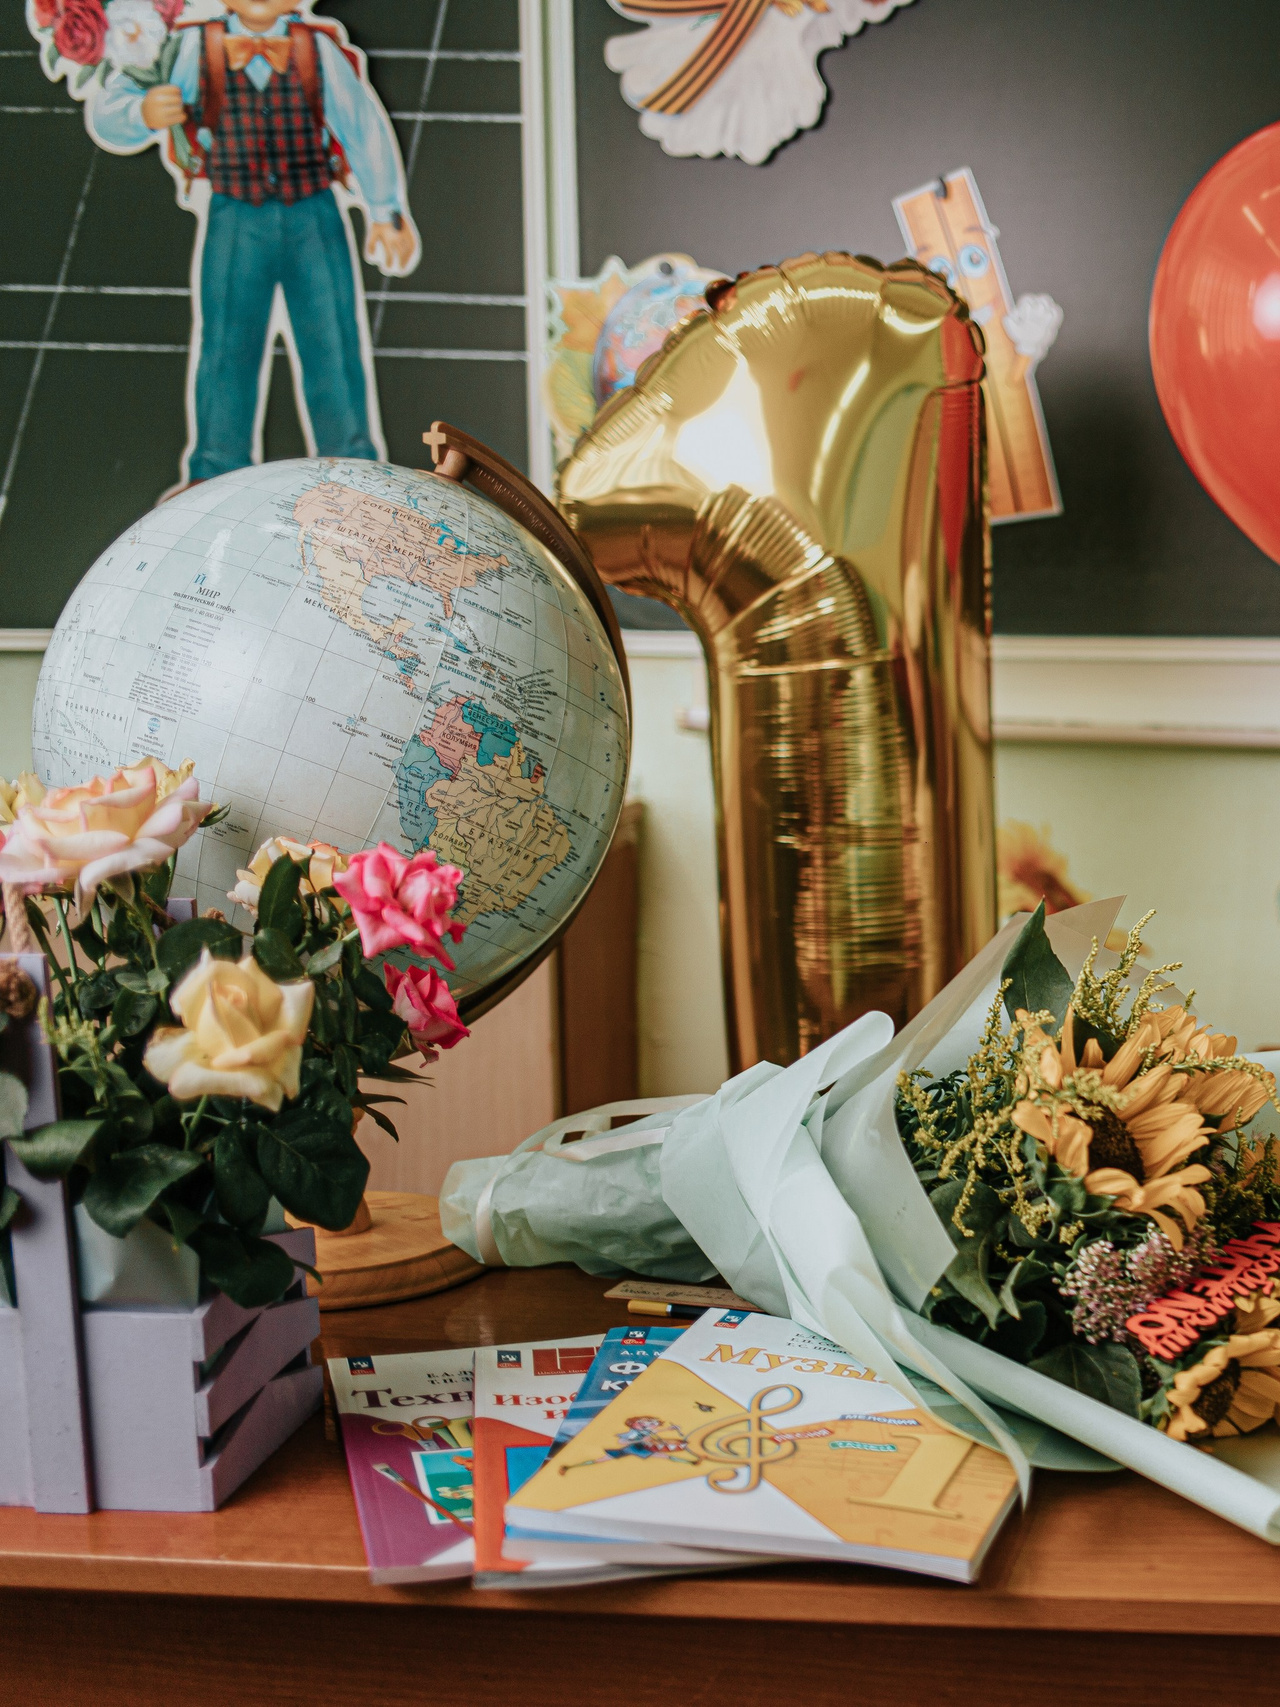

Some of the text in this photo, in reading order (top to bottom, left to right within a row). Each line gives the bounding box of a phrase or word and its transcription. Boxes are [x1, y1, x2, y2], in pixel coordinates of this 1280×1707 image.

[336, 525, 437, 566] ШТАТЫ АМЕРИКИ
[172, 589, 236, 614] политический глобус
[196, 586, 220, 600] МИР
[384, 585, 435, 608] Мексиканский
[173, 602, 194, 613] Масштаб
[303, 597, 349, 618] МЕКСИКА
[392, 598, 412, 608] залив
[462, 597, 504, 619] САРГАССОВО
[505, 617, 523, 628] МОРЕ
[381, 674, 411, 689] КОСТА-РИКА
[437, 662, 477, 682] КАРИБСКОЕ
[479, 679, 497, 690] МОРЕ
[402, 689, 424, 701] ПАНАМА
[466, 710, 509, 731] ВЕНЕСУЭЛА
[379, 732, 405, 745] ЭКВАДОР
[441, 732, 477, 750] КОЛУМБИЯ
[407, 801, 433, 816] ПЕРУ
[432, 830, 468, 848] БОЛИВИЯ
[469, 828, 537, 864] БРАЗИЛИЯ
[846, 1414, 918, 1426] МЕЛОДИЯ
[847, 1433, 975, 1520] 1
